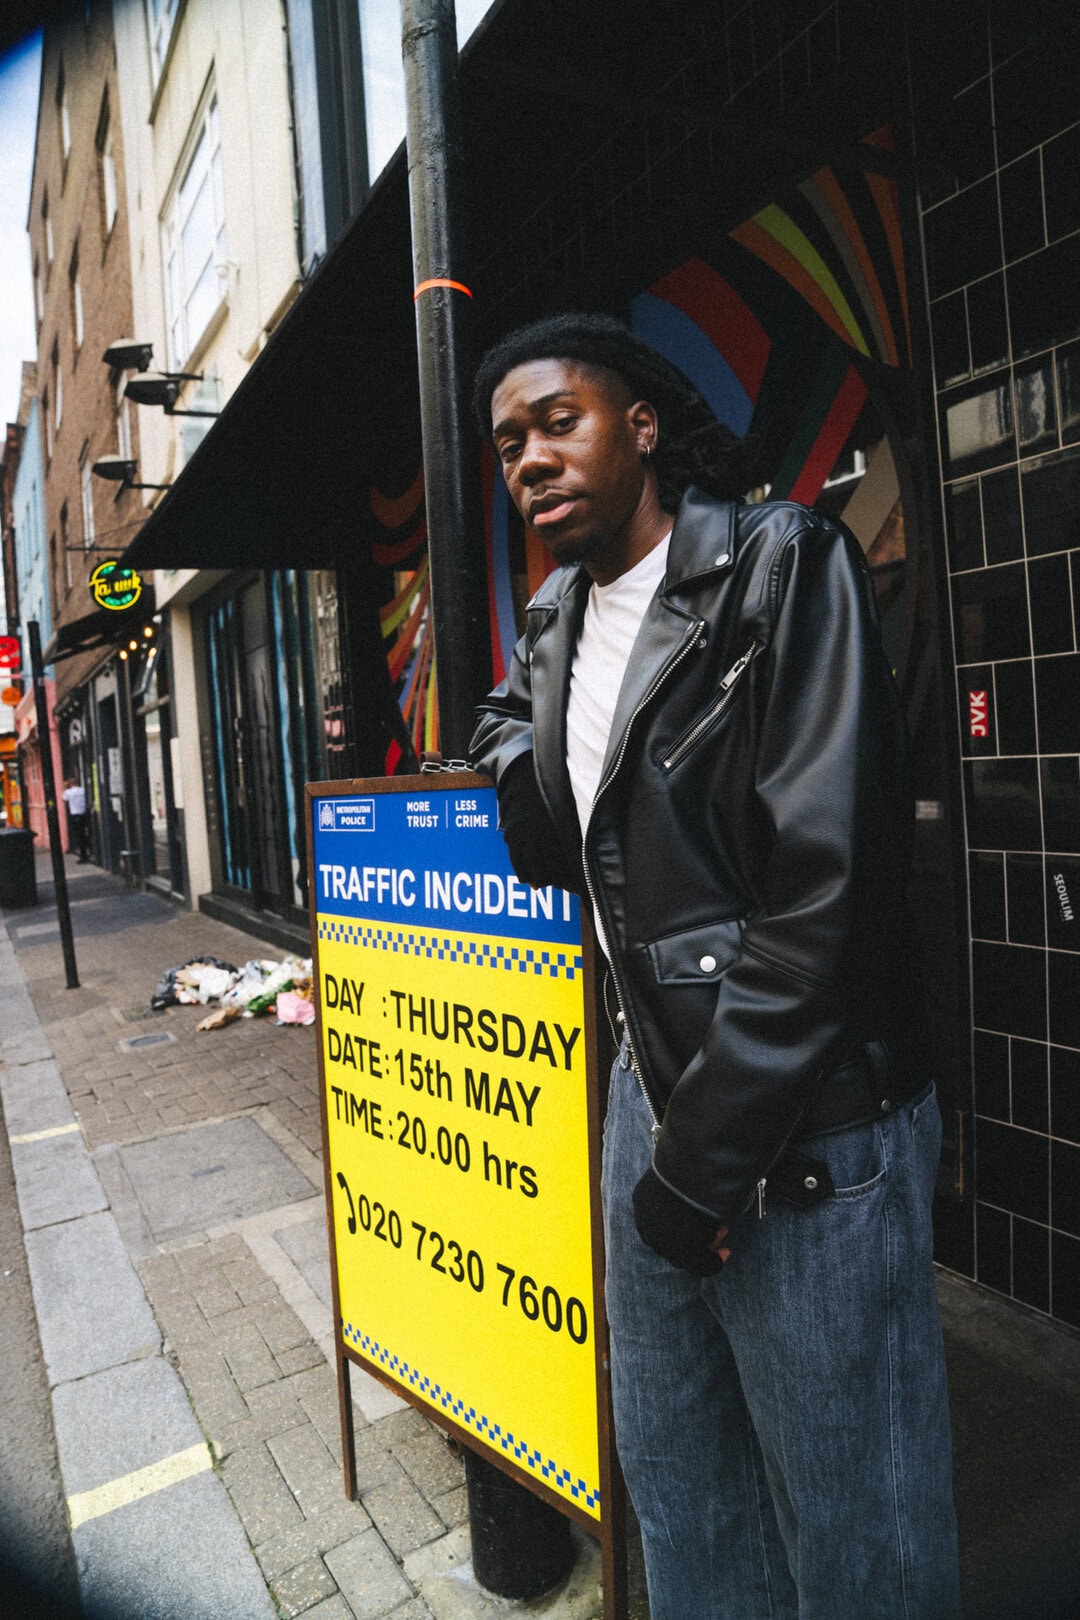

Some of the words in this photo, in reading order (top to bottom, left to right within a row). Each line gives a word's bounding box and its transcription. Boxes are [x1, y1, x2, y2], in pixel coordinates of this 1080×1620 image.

[970, 692, 987, 736] JVK
[340, 816, 366, 826] POLICE
[406, 801, 430, 812] MORE
[406, 815, 439, 828] TRUST
[455, 800, 477, 811] LESS
[455, 815, 489, 828] CRIME
[319, 864, 416, 907] TRAFFIC
[1053, 873, 1074, 921] SEOULIM
[325, 973, 365, 1016] DAY
[464, 1067, 542, 1127] MAY
[482, 1140, 539, 1199] hrs
[358, 1194, 402, 1249] 020
[411, 1220, 485, 1293] 7230
[496, 1262, 588, 1345] 7600
